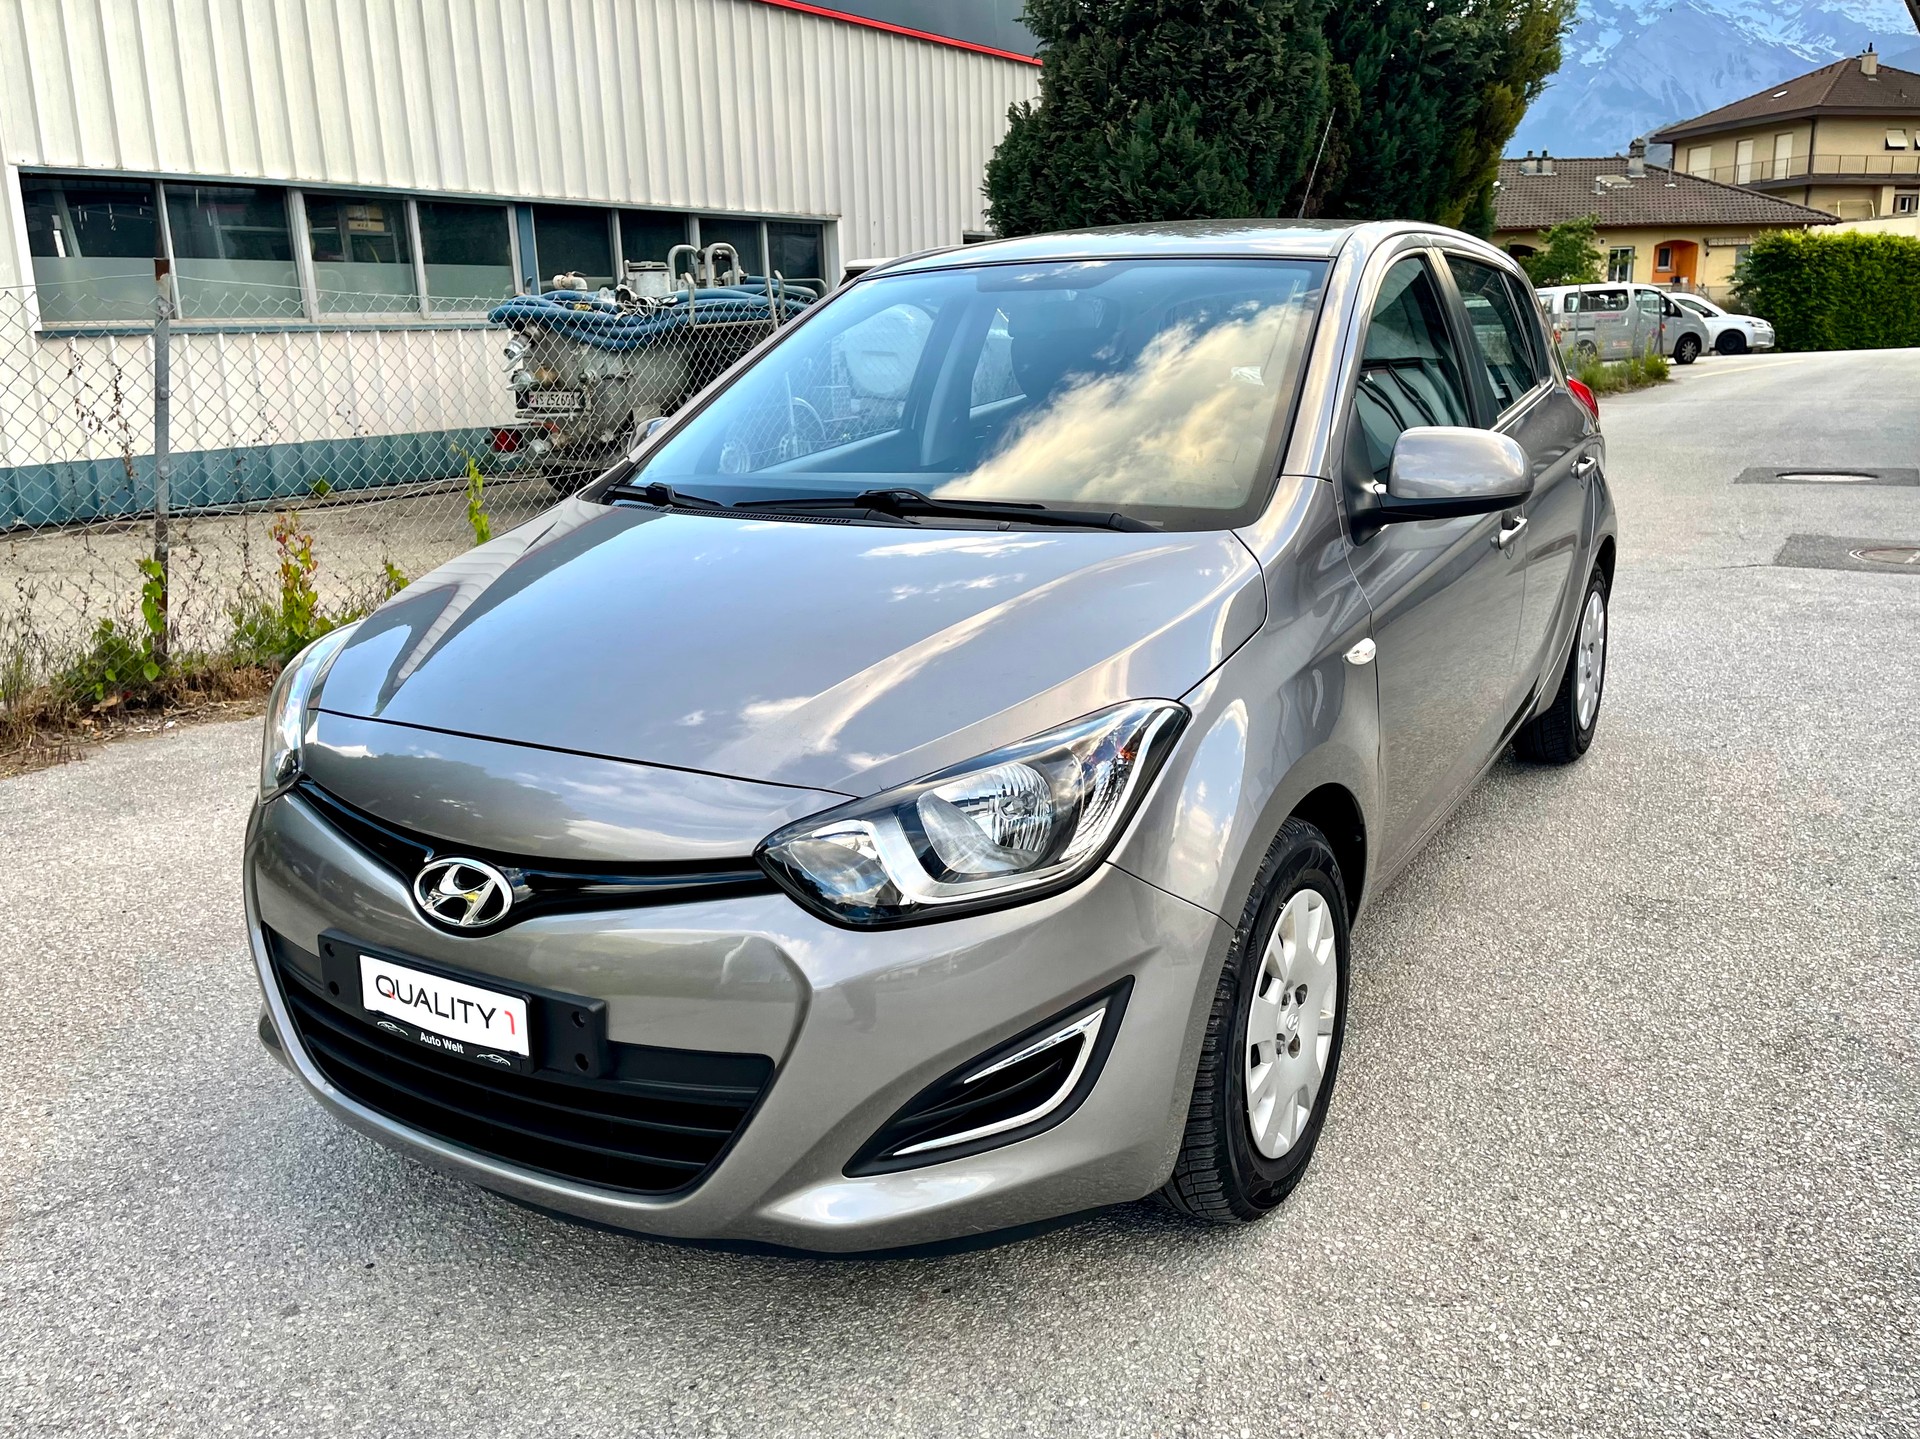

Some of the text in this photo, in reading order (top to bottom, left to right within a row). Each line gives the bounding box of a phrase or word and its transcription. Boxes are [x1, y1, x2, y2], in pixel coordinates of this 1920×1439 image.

[375, 974, 515, 1035] QUALITY 1
[420, 1031, 465, 1054] Auto Welt
